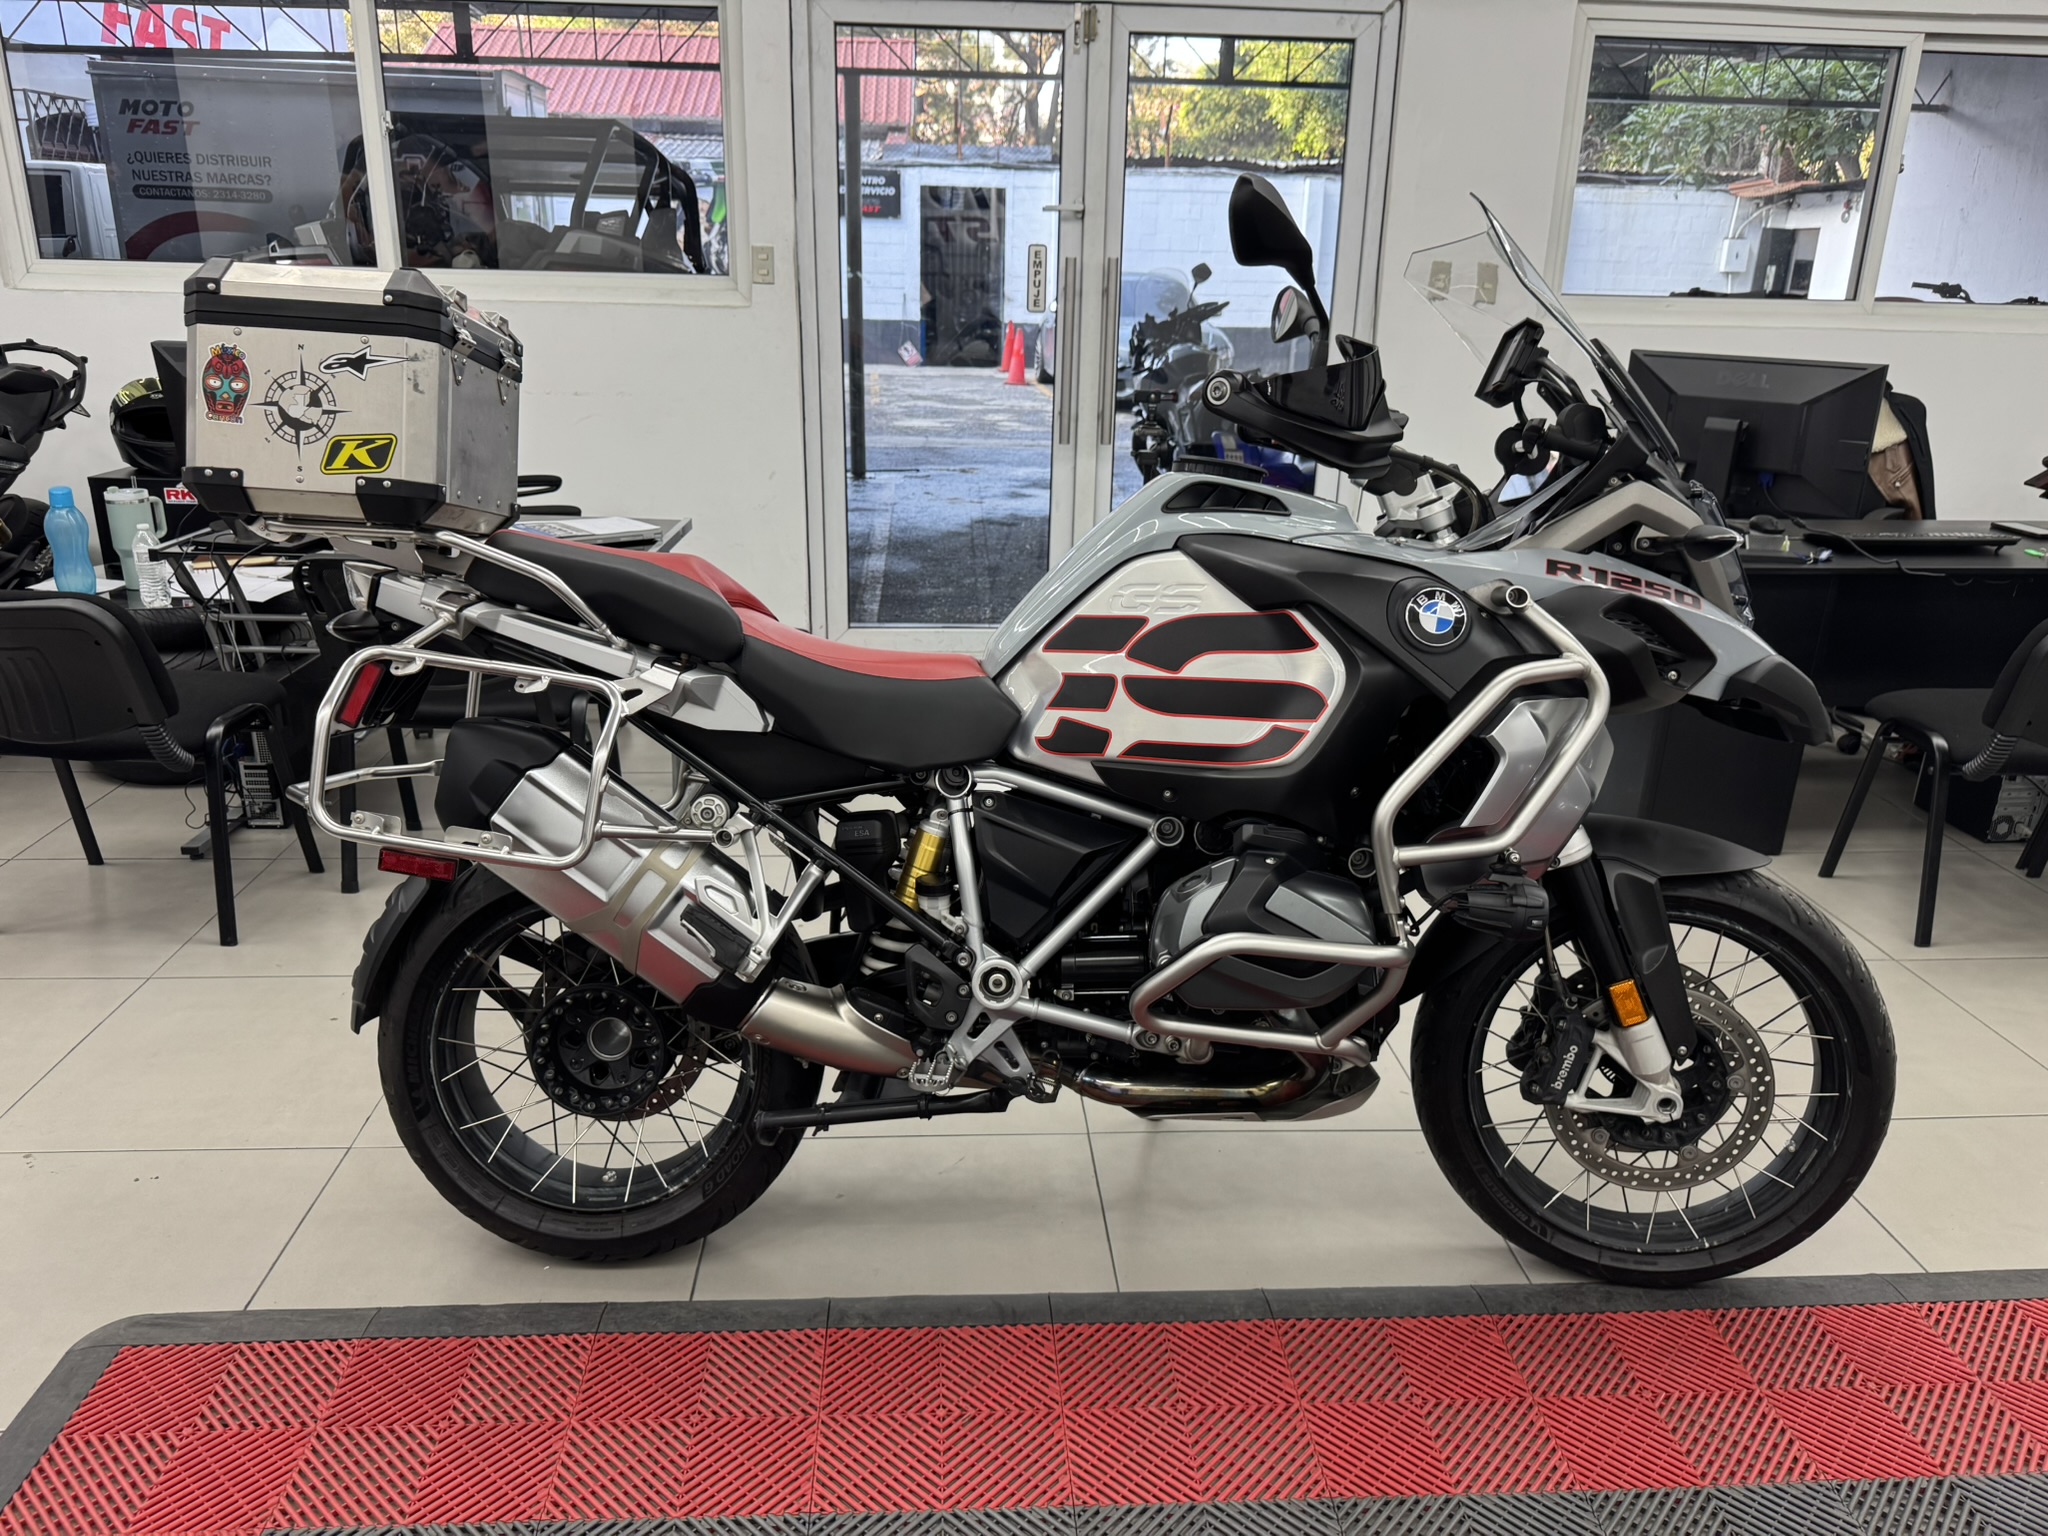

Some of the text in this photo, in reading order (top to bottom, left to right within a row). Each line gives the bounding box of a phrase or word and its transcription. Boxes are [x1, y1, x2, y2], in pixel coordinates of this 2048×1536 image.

[101, 3, 231, 49] FAST
[118, 99, 194, 117] MOTO
[126, 118, 200, 136] FAST
[126, 151, 272, 168] ¿QUIERES DISTRIBUIR
[132, 169, 271, 186] NUESTRAS MARCAS?
[1033, 250, 1042, 308] EMPUJE
[326, 440, 391, 470] K
[166, 489, 195, 500] RK
[1546, 558, 1702, 611] R 1250
[1110, 583, 1207, 614] GS
[1416, 591, 1463, 613] BMW
[854, 829, 870, 837] ESA
[1551, 1045, 1578, 1090] brembo
